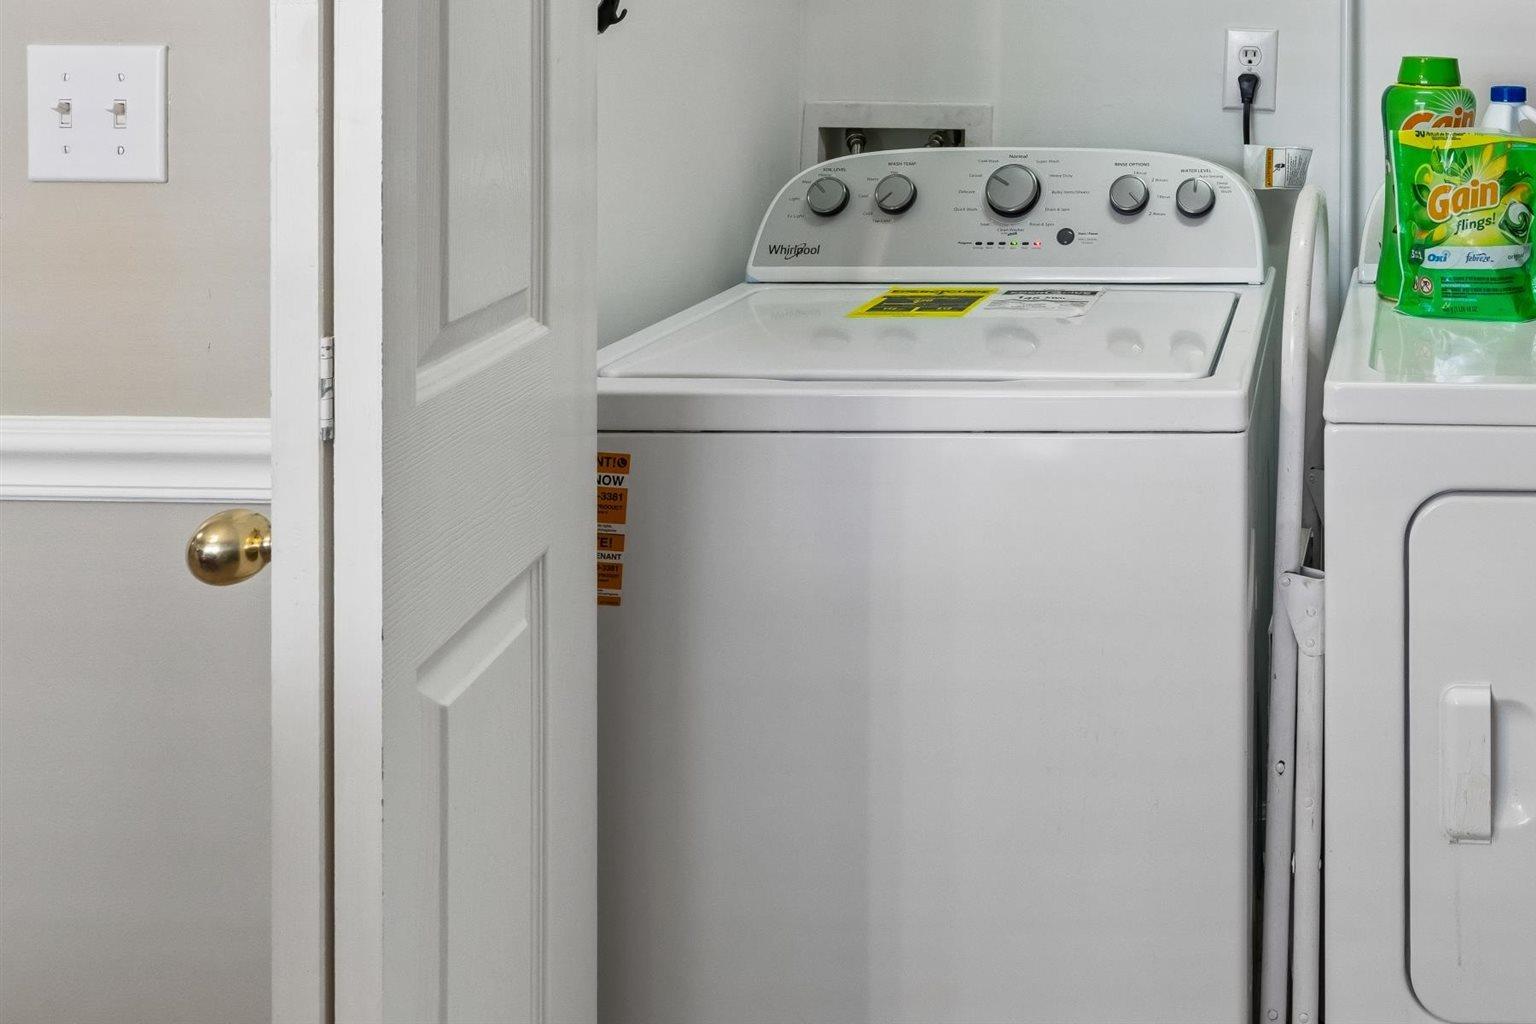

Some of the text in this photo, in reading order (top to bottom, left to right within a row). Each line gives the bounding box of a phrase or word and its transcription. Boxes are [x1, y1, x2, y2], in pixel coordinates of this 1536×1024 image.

[1427, 178, 1500, 223] Gain
[1454, 212, 1497, 235] flings!
[768, 244, 820, 258] Whirlpool
[1427, 252, 1448, 263] Oxi
[1466, 252, 1491, 264] febreze
